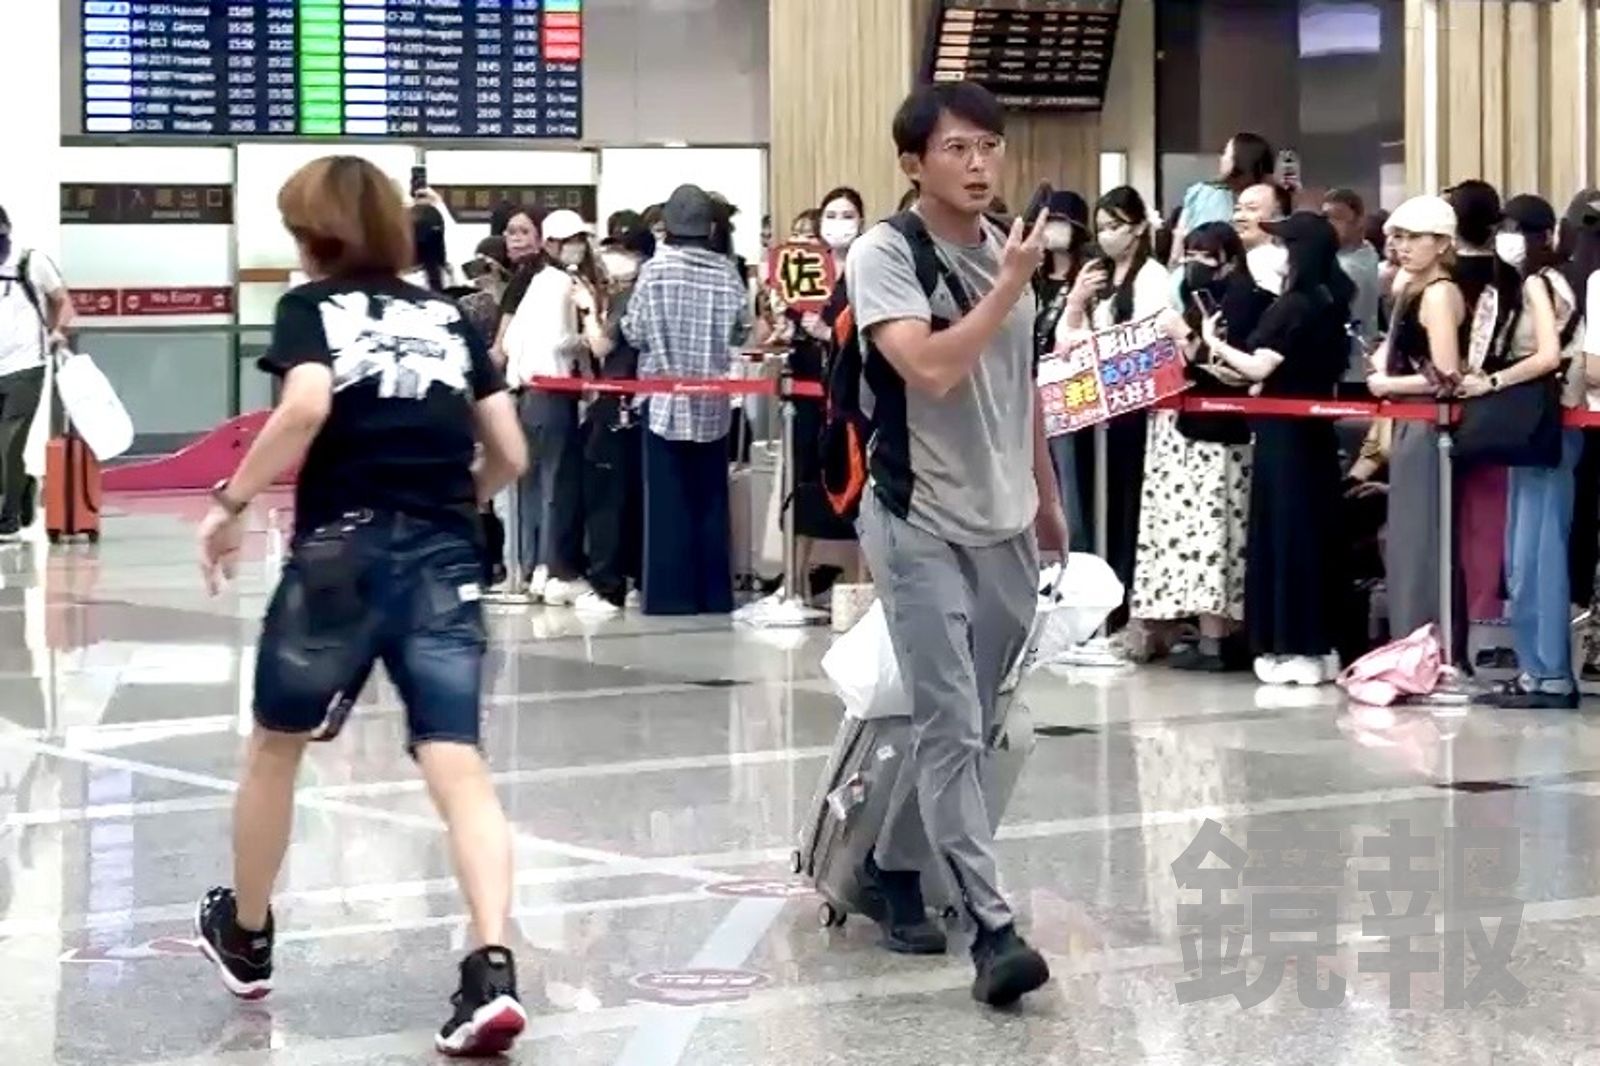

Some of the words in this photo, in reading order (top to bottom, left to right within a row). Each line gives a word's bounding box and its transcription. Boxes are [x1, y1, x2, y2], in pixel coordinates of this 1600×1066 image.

[778, 250, 829, 301] 佐
[150, 292, 168, 303] No
[171, 291, 201, 305] Entry
